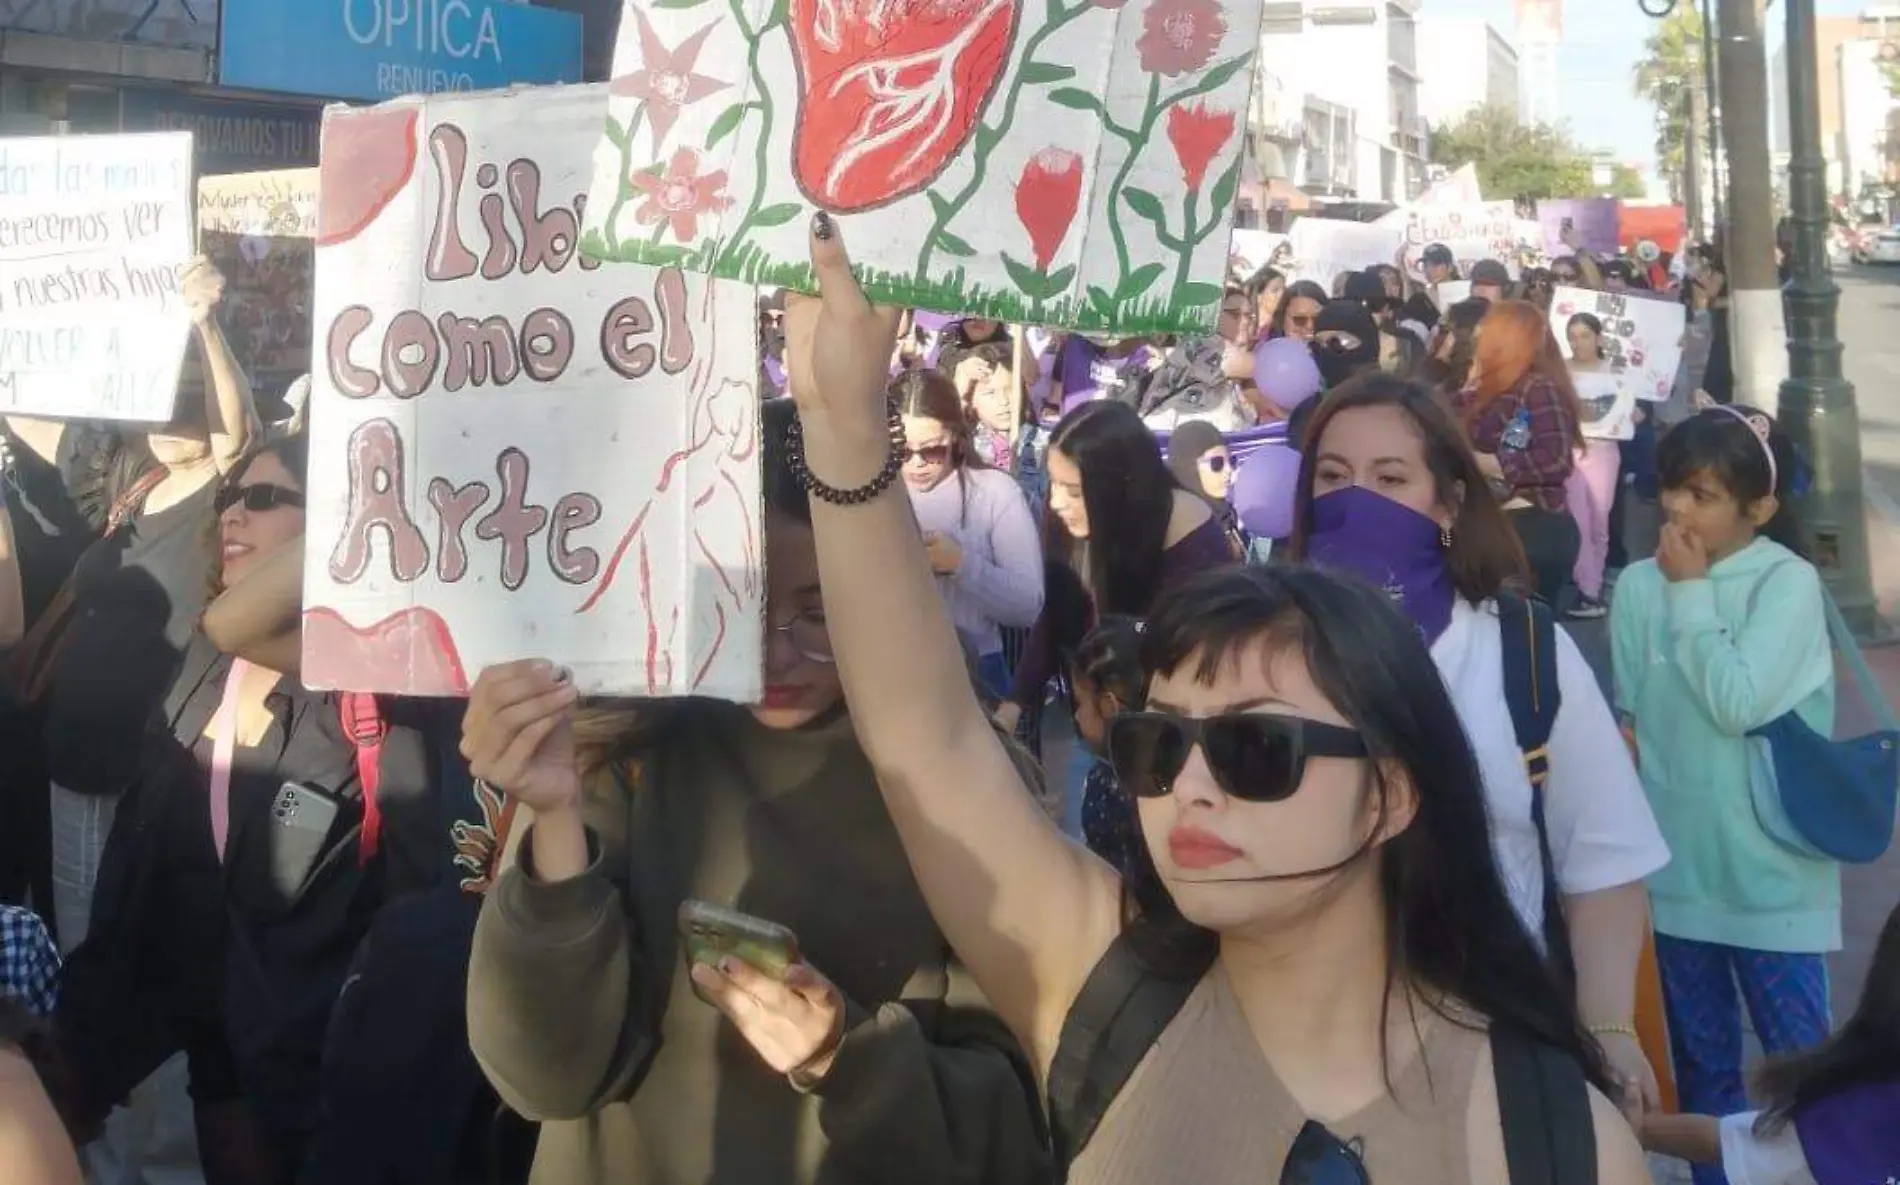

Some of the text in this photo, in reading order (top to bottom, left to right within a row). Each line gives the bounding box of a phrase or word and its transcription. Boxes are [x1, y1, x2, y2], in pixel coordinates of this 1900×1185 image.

[14, 264, 120, 307] nuestras
[327, 266, 694, 400] como el
[329, 417, 602, 591] Arte
